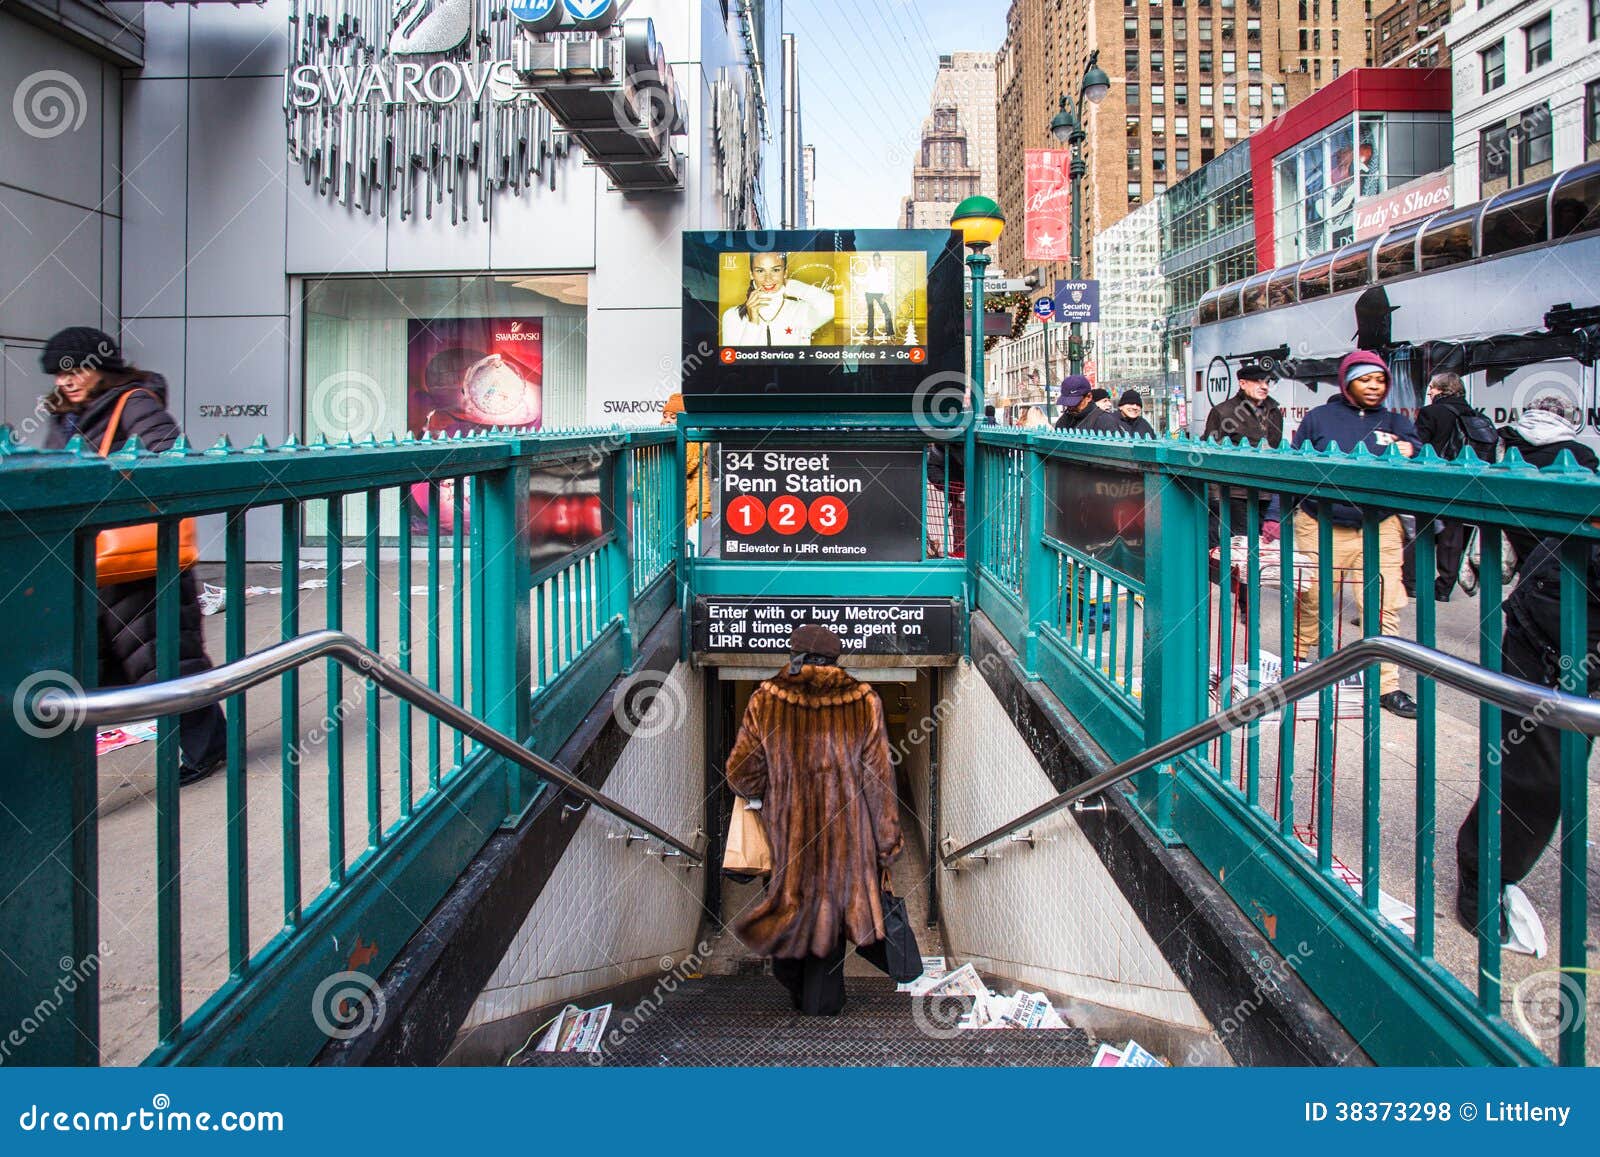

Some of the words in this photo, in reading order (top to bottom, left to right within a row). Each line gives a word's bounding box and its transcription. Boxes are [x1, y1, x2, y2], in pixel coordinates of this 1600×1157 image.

[292, 62, 516, 107] SWAROVS
[1356, 202, 1400, 230] Lady's
[1402, 185, 1450, 215] Shoes
[1062, 303, 1092, 312] Security
[496, 332, 540, 342] SWAROVSKI
[724, 351, 732, 360] 2
[735, 351, 758, 360] Good
[760, 351, 794, 360] Service
[799, 352, 804, 360] 2
[815, 351, 840, 360] Good
[842, 351, 876, 360] Service
[880, 351, 886, 360] 2
[914, 350, 920, 360] 2
[1210, 377, 1228, 392] TNT
[200, 404, 268, 418] SWAROVSKI
[726, 452, 754, 471] 34
[764, 452, 829, 471] Street
[726, 474, 776, 492] Penn
[786, 474, 862, 492] Station
[738, 504, 752, 526] 1
[778, 504, 796, 526] 2
[819, 504, 837, 526] 3
[740, 544, 780, 554] Elevator
[784, 544, 792, 553] in
[796, 544, 818, 553] LIRR
[822, 546, 866, 554] entrance
[710, 606, 748, 619] Enter
[754, 607, 784, 619] with
[790, 610, 806, 620] or
[812, 608, 839, 622] buy
[845, 607, 924, 620] MetroCard
[710, 623, 726, 633] at
[730, 622, 746, 633] all
[752, 622, 792, 633] times
[854, 622, 896, 637] agent
[902, 624, 921, 634] on
[709, 636, 742, 648] LIRR
